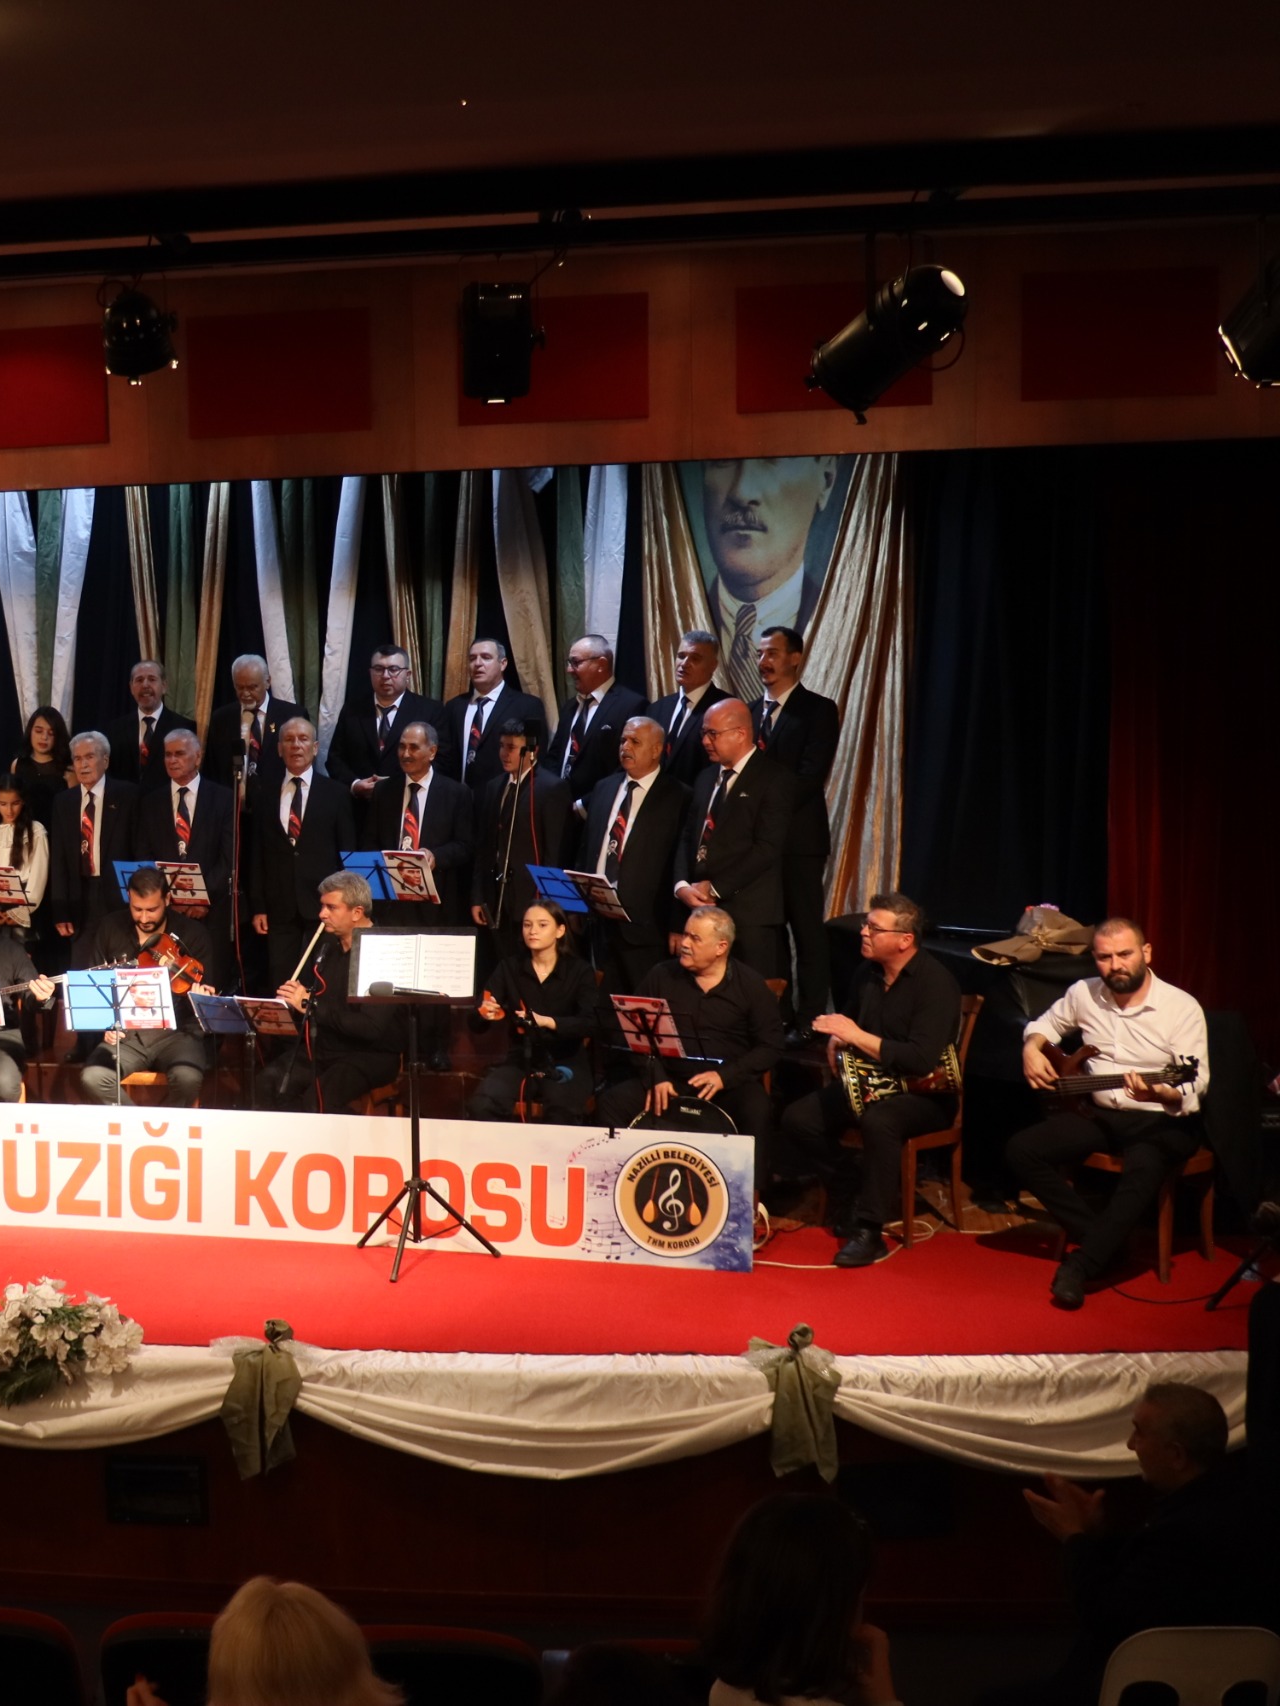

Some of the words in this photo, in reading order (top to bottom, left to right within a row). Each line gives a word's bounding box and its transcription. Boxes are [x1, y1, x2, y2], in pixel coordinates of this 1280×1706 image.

[627, 1149, 661, 1183] NAZİLLİ
[663, 1150, 720, 1188] BELEDİYESİ
[234, 1150, 587, 1248] KOROSU
[646, 1235, 666, 1249] THM
[667, 1236, 701, 1250] KOROSU
